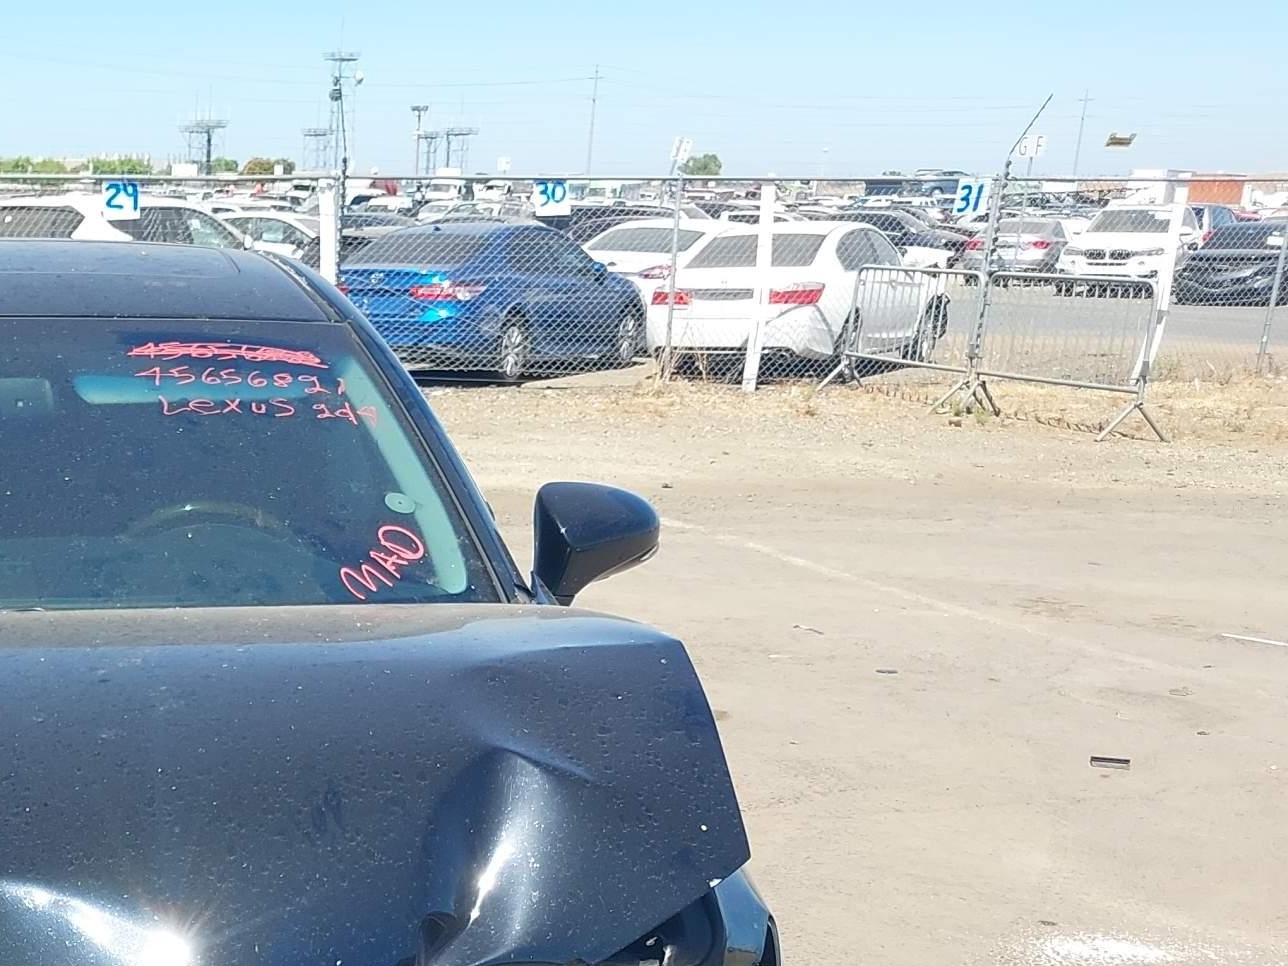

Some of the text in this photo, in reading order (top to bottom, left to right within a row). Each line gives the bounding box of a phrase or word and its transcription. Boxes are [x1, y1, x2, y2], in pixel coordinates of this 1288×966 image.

[105, 180, 140, 212] 29
[535, 179, 567, 207] 30
[956, 184, 984, 213] 31
